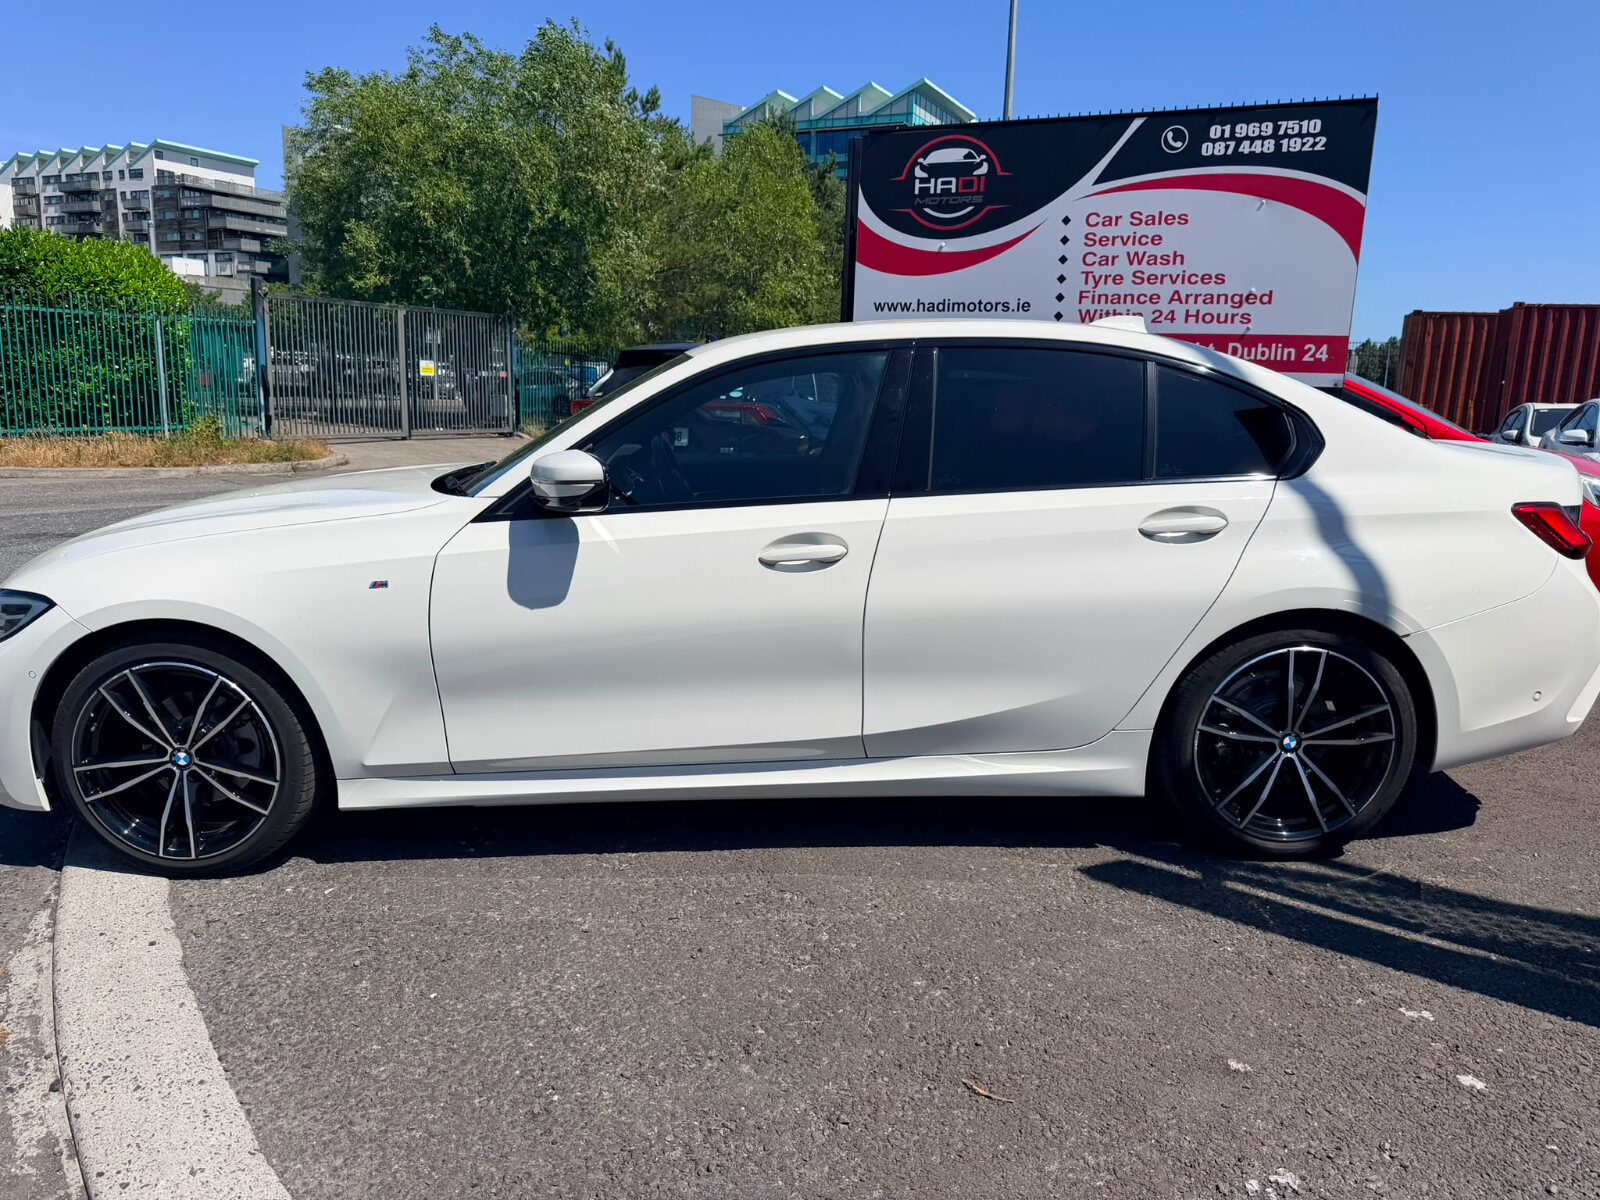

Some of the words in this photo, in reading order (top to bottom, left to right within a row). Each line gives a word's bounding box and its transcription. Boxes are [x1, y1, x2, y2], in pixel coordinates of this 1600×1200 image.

[1209, 124, 1231, 139] 01
[1234, 121, 1274, 138] 969
[1277, 119, 1322, 135] 7510
[1201, 141, 1236, 156] 087
[1238, 139, 1275, 154] 448
[1279, 136, 1327, 152] 1922
[914, 176, 986, 195] HADI
[914, 195, 984, 206] MOTORS
[1085, 212, 1122, 228] Car
[1129, 211, 1189, 226] Sales
[1083, 231, 1163, 247] Service
[1081, 251, 1119, 267] Car
[1126, 251, 1185, 266] Wash
[1081, 270, 1124, 289] Tyre
[1131, 270, 1226, 285] Services
[874, 298, 1031, 312] www.hadimotors.ie
[1078, 290, 1161, 305] Finance
[1168, 289, 1274, 309] Arranged
[1150, 309, 1176, 324] 24
[1184, 309, 1252, 324] Hours
[1227, 342, 1296, 361] Dublin
[1302, 344, 1328, 362] 24
